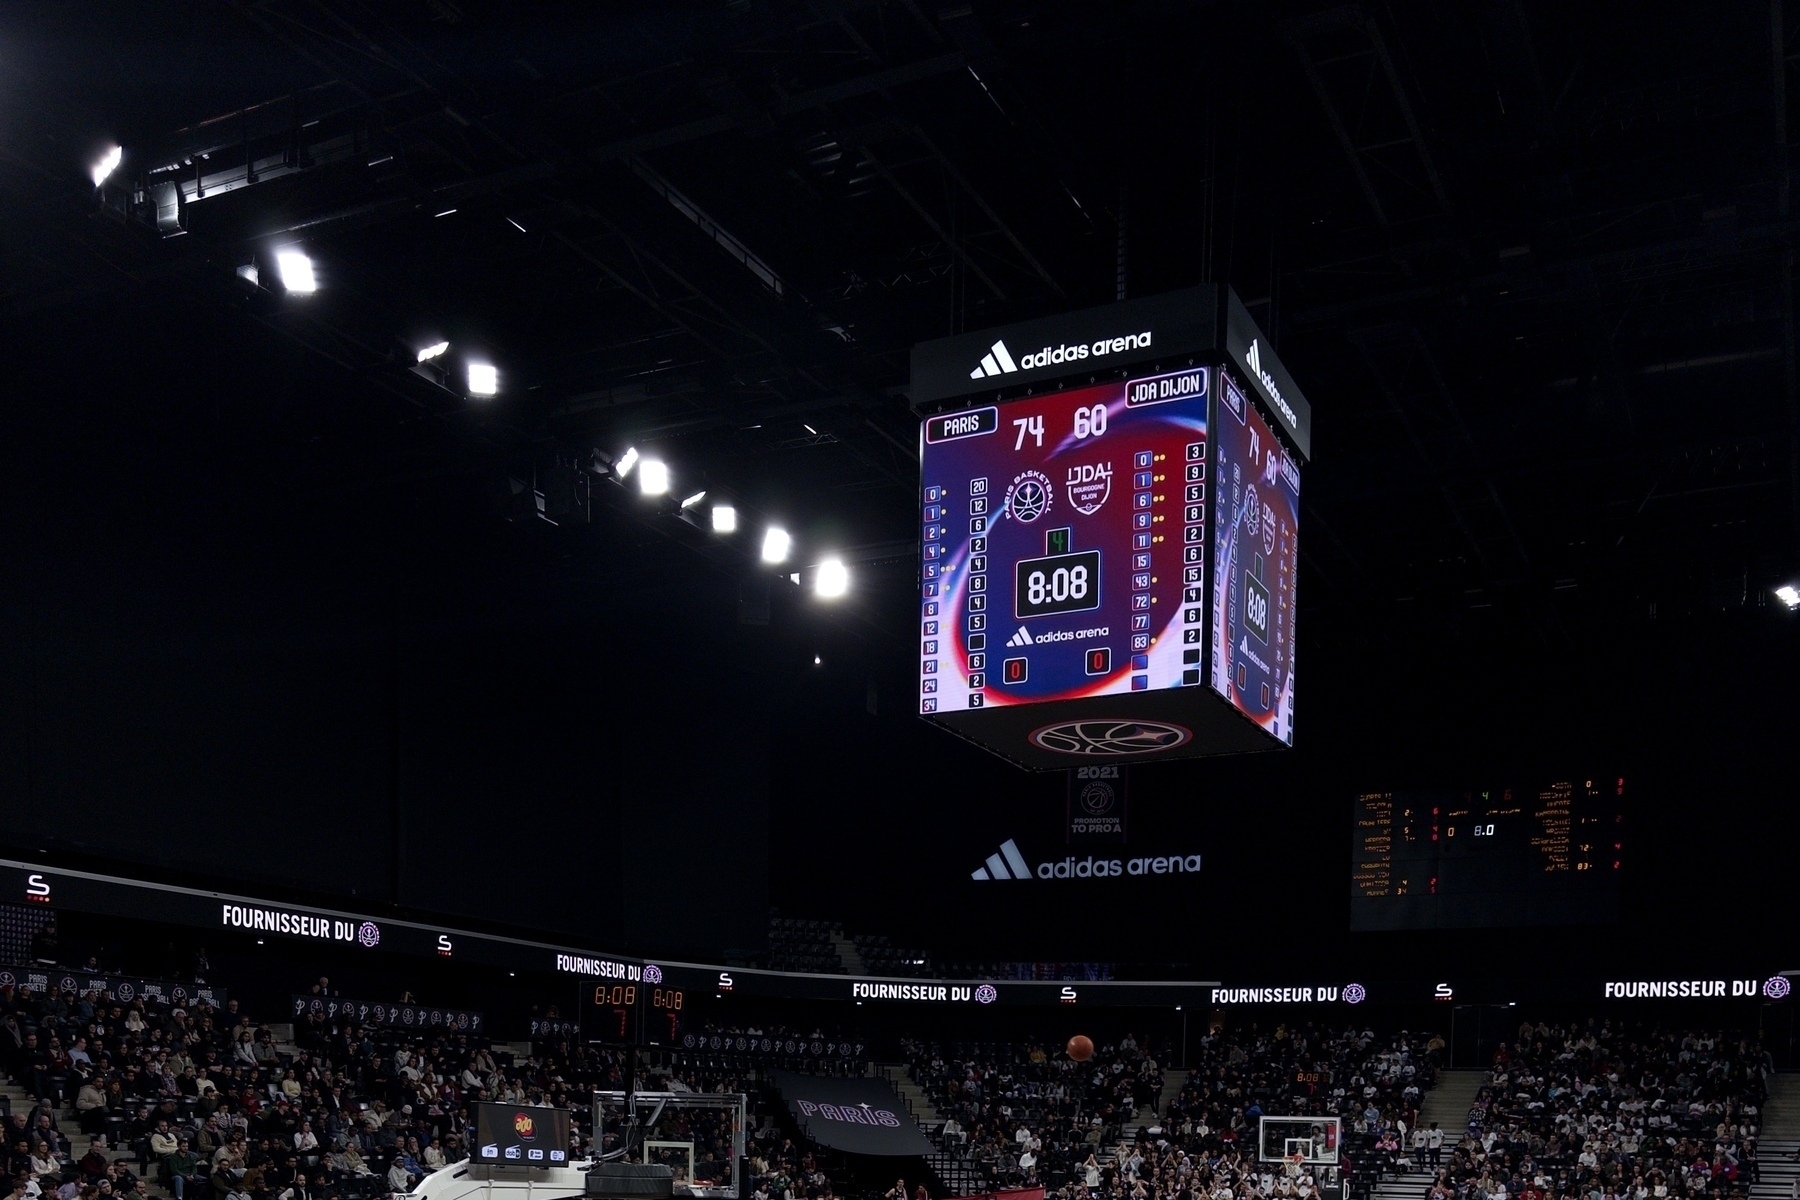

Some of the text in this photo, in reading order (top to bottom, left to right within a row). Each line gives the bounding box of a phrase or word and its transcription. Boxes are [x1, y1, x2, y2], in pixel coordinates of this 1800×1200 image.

[1021, 331, 1151, 370] adidas arena
[1131, 375, 1200, 403] JDA DIJON
[1261, 370, 1297, 429] adidas arena
[943, 415, 980, 436] PARIS
[1074, 403, 1108, 439] 60
[1013, 415, 1045, 451] 74
[1249, 425, 1260, 466] 74
[1192, 446, 1199, 458] 3
[1140, 454, 1147, 466] 0
[1191, 466, 1199, 479] 9
[1266, 449, 1277, 486] 60
[1141, 474, 1145, 487] 1
[973, 481, 985, 493] 20
[1073, 483, 1105, 493] BOURGOGNE
[1191, 487, 1198, 499] 5
[930, 489, 936, 500] 0
[1004, 470, 1054, 520] PARIS BASKETBALL
[1081, 492, 1098, 501] DIJON
[974, 500, 983, 512] 12
[1140, 495, 1147, 507] 6
[931, 509, 935, 519] 1
[1191, 507, 1198, 519] 8
[975, 520, 982, 531] 6
[1139, 515, 1146, 527] 9
[929, 528, 935, 539] 2
[1190, 528, 1198, 540] 2
[975, 539, 982, 551] 2
[1138, 535, 1146, 547] 11
[929, 547, 935, 558] 4
[1190, 548, 1197, 560] 6
[975, 559, 981, 570] 4
[1137, 555, 1147, 567] 15
[928, 566, 934, 577] 5
[1188, 569, 1198, 581] 15
[974, 578, 981, 589] 8
[1027, 565, 1088, 605] 8:08
[1135, 575, 1148, 588] 43
[928, 585, 934, 596] 7
[1189, 589, 1196, 601] 4
[974, 597, 981, 609] 4
[1135, 596, 1147, 608] 72
[928, 604, 934, 615] 8
[1248, 586, 1266, 631] 8:08
[1135, 616, 1147, 628] 77
[1189, 610, 1196, 622] 6
[927, 623, 935, 634] 12
[974, 617, 981, 628] 5
[1035, 626, 1109, 644] adidas arena
[1188, 630, 1196, 642] 2
[926, 642, 935, 653] 18
[1134, 636, 1147, 648] 83
[926, 661, 935, 672] 21
[973, 656, 980, 667] 6
[1093, 652, 1103, 670] 0
[1011, 662, 1020, 679] 0
[925, 681, 935, 692] 24
[973, 675, 980, 687] 2
[924, 701, 935, 711] 34
[973, 695, 980, 706] 5
[1077, 766, 1120, 779] 2021
[1071, 823, 1122, 834] TO PRO A
[1037, 854, 1201, 879] adidas arena
[223, 904, 331, 940] FOURNISSEUR
[334, 921, 354, 942] DU
[557, 954, 626, 980] FOURNISSEUR
[627, 965, 641, 982] DU
[853, 982, 947, 1001] FOURNISSEUR
[951, 987, 971, 1002] DU
[1604, 980, 1726, 998] FOURNISSEUR
[1732, 979, 1757, 996] DU
[594, 986, 636, 1005] 8:08
[653, 988, 683, 1010] 8:08
[1211, 987, 1312, 1004] FOURNISSEUR
[1317, 986, 1338, 1002] DU
[797, 1100, 901, 1128] PARIS
